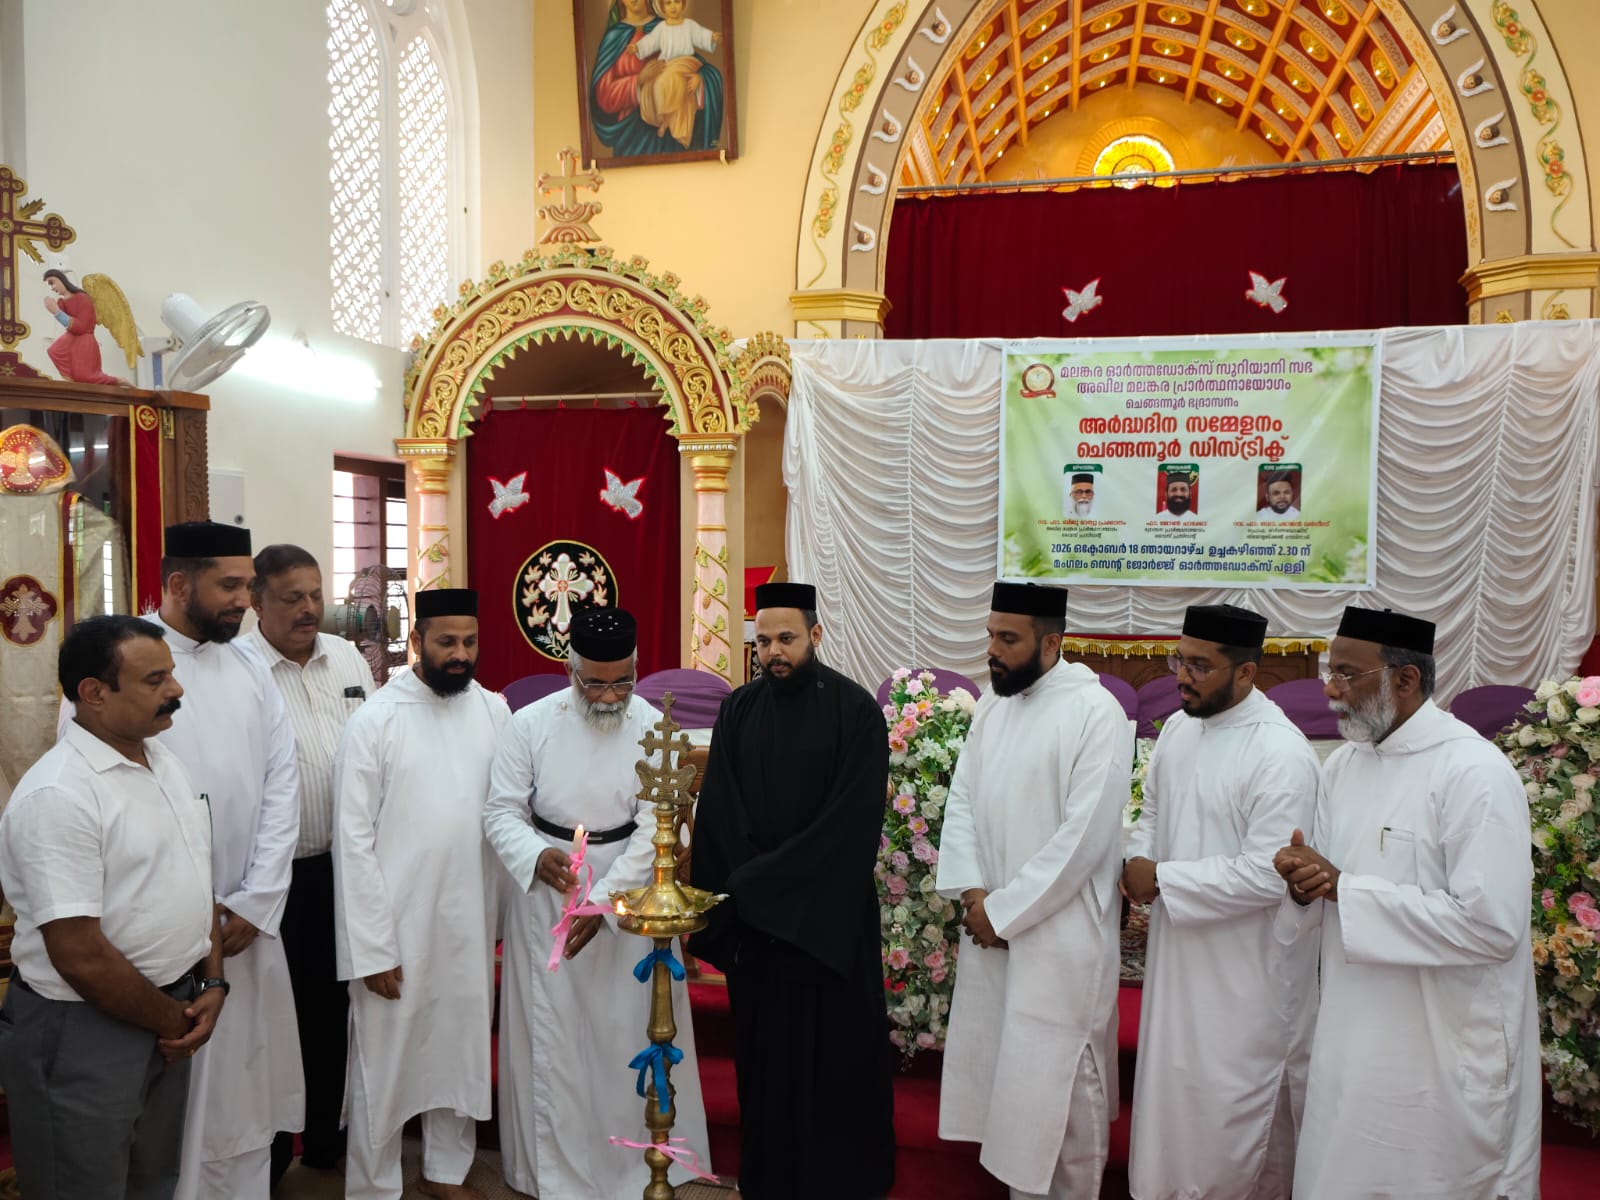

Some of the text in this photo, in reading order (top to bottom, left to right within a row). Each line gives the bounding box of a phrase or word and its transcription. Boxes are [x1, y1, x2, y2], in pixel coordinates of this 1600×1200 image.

[1060, 358, 1312, 378] മലങ്കര ഓർത്തഡോക്സ് സുറിയാനി സഭ
[1077, 378, 1291, 394] അഖില മലങ്കര പ്രാർത്ഥനായോഗം
[1126, 396, 1238, 410] ചെങ്ങന്നൂർ ഭദ്രാസനം
[1078, 412, 1282, 435] അർദ്ധദിന സമ്മേളനം
[1077, 438, 1182, 462] ചെങ്ങന്നൂർ
[1051, 544, 1072, 553] 2026
[1129, 544, 1138, 554] 18
[1140, 542, 1204, 554] ഞായറാഴ്ച
[1278, 546, 1298, 556] 2.30
[1300, 544, 1311, 556] ന്
[1054, 558, 1088, 569] മംഗലം
[1178, 558, 1272, 572] ഓർത്തഡോക്സ്
[1274, 560, 1305, 574] പള്ളി
